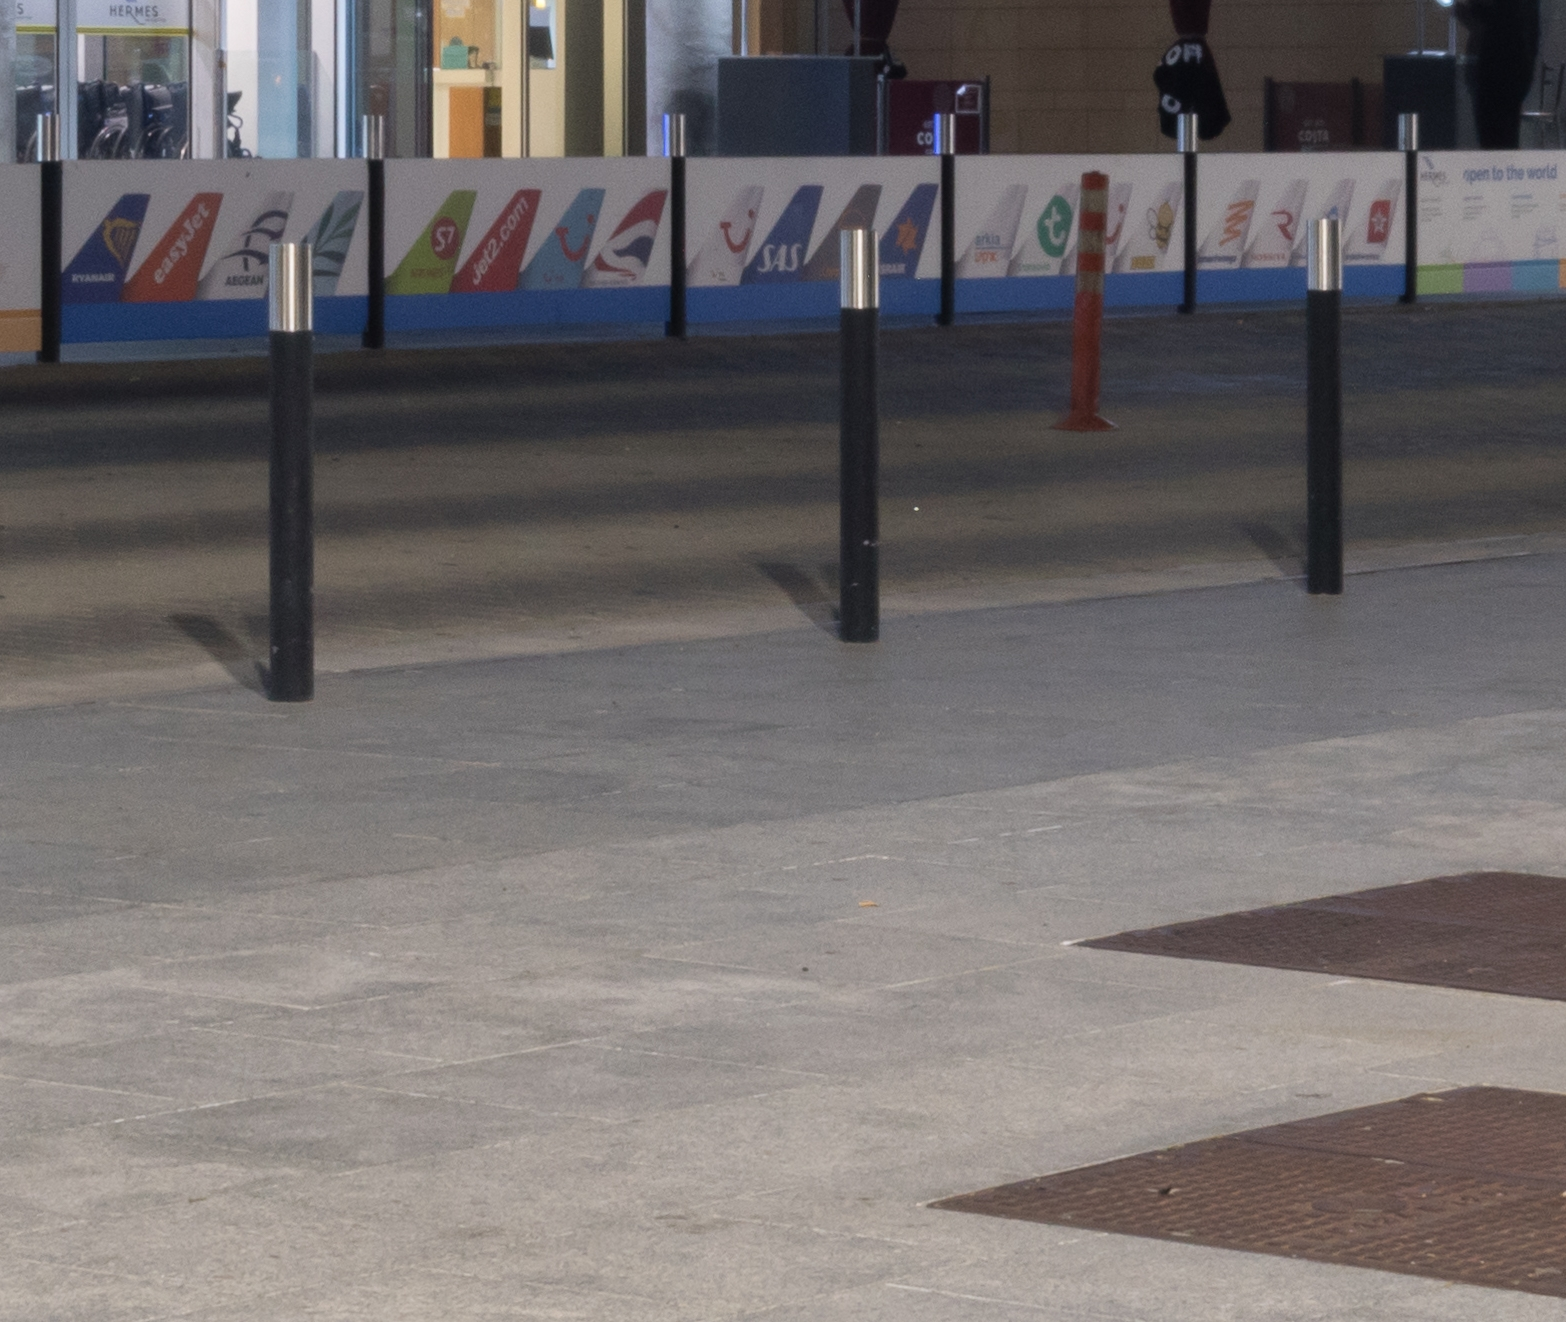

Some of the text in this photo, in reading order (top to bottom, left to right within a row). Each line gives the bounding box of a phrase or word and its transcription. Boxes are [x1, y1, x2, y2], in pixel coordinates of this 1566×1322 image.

[109, 4, 159, 21] HERMES
[1492, 166, 1504, 181] to
[1506, 165, 1525, 181] the
[1527, 163, 1557, 180] world
[152, 201, 211, 285] easyJet
[433, 225, 456, 252] S7
[472, 196, 529, 285] Jet2.com
[757, 243, 801, 272] SAS
[71, 273, 115, 284] RYANAIR
[224, 275, 264, 287] AEGEAN
